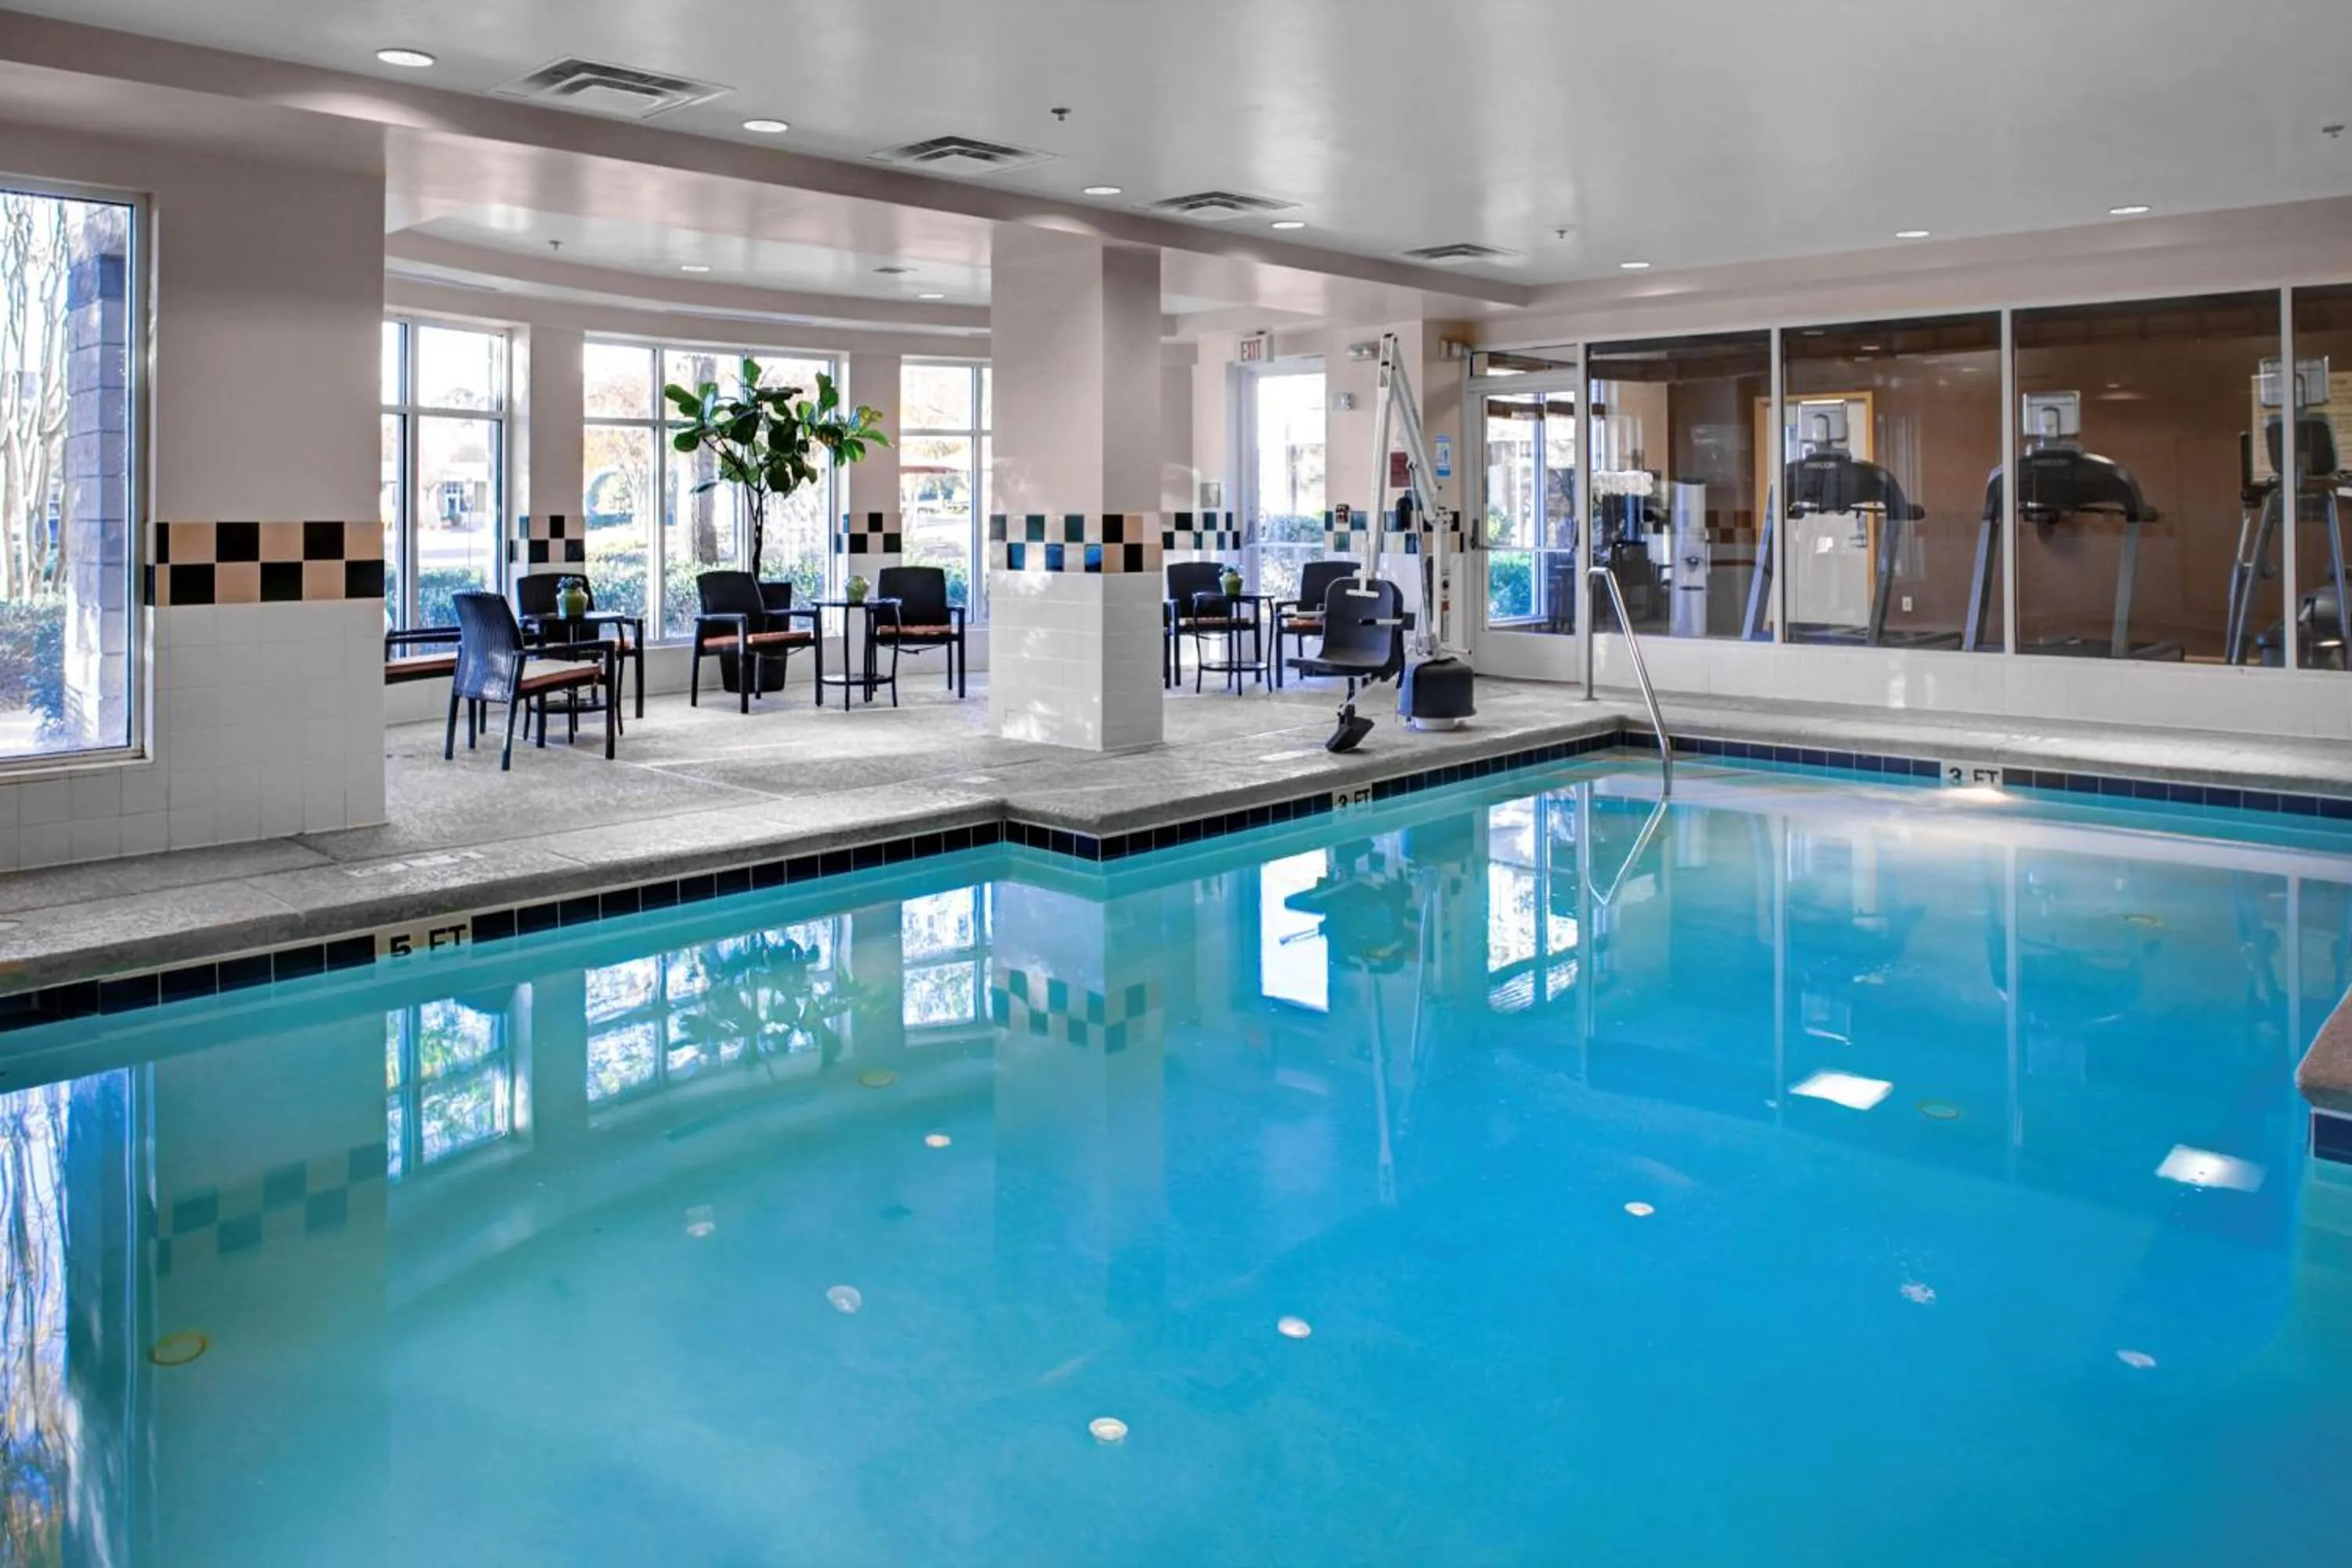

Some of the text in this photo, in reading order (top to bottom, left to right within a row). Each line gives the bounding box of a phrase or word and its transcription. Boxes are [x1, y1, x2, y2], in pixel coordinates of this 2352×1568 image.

[1240, 339, 1261, 362] EXIT
[1973, 769, 1998, 784] FT
[1355, 788, 1370, 805] FT
[390, 924, 466, 957] 5 FT
